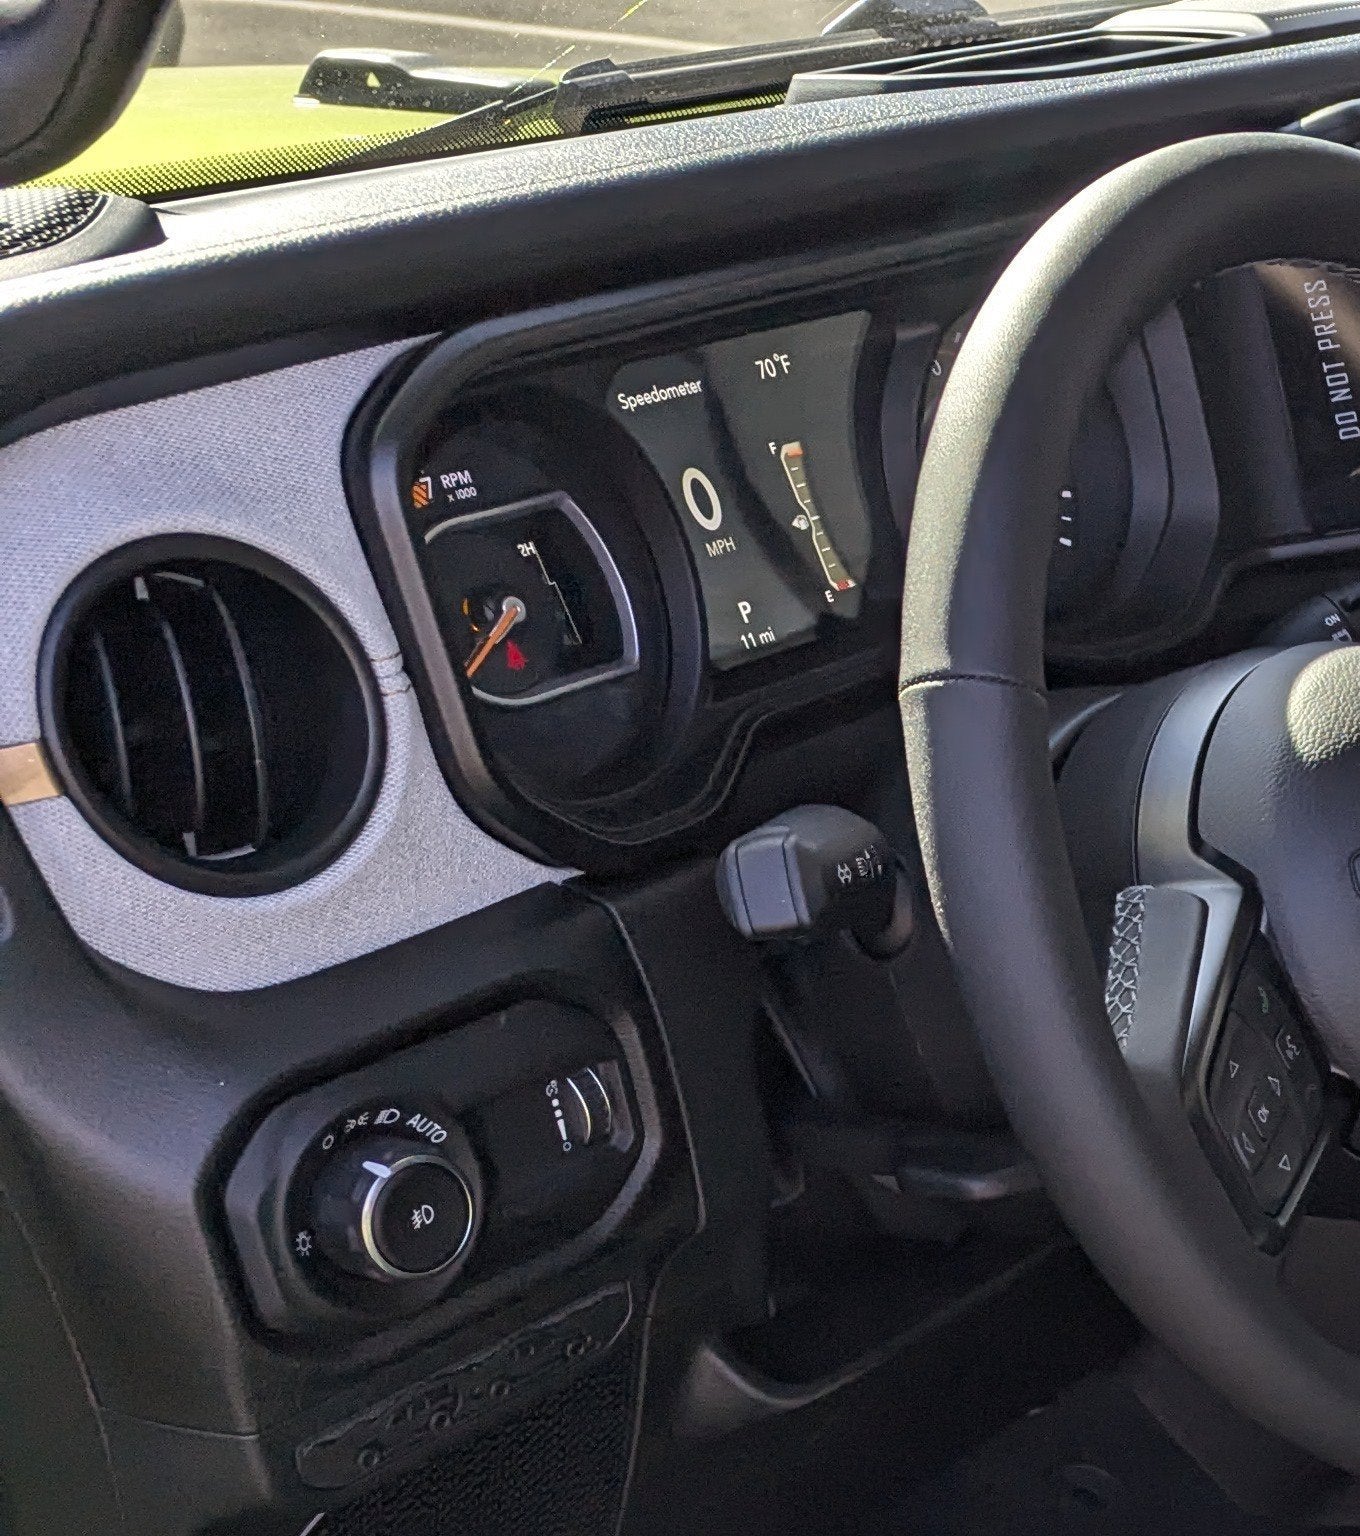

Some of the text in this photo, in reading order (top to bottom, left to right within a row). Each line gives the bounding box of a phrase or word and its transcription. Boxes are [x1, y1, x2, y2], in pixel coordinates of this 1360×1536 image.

[1304, 279, 1341, 351] PRESS
[1322, 361, 1353, 402] NOT
[618, 380, 703, 412] Speedometer
[768, 442, 777, 455] F
[418, 476, 433, 500] 7
[440, 470, 473, 489] RPM
[455, 486, 478, 500] 1000
[682, 467, 722, 531] 0
[517, 541, 536, 557] 2H
[705, 537, 736, 557] MPH
[824, 590, 835, 603] E
[737, 601, 752, 624] P
[1325, 613, 1341, 627] ON
[740, 626, 776, 650] 11 mi
[406, 1113, 447, 1144] AUTO
